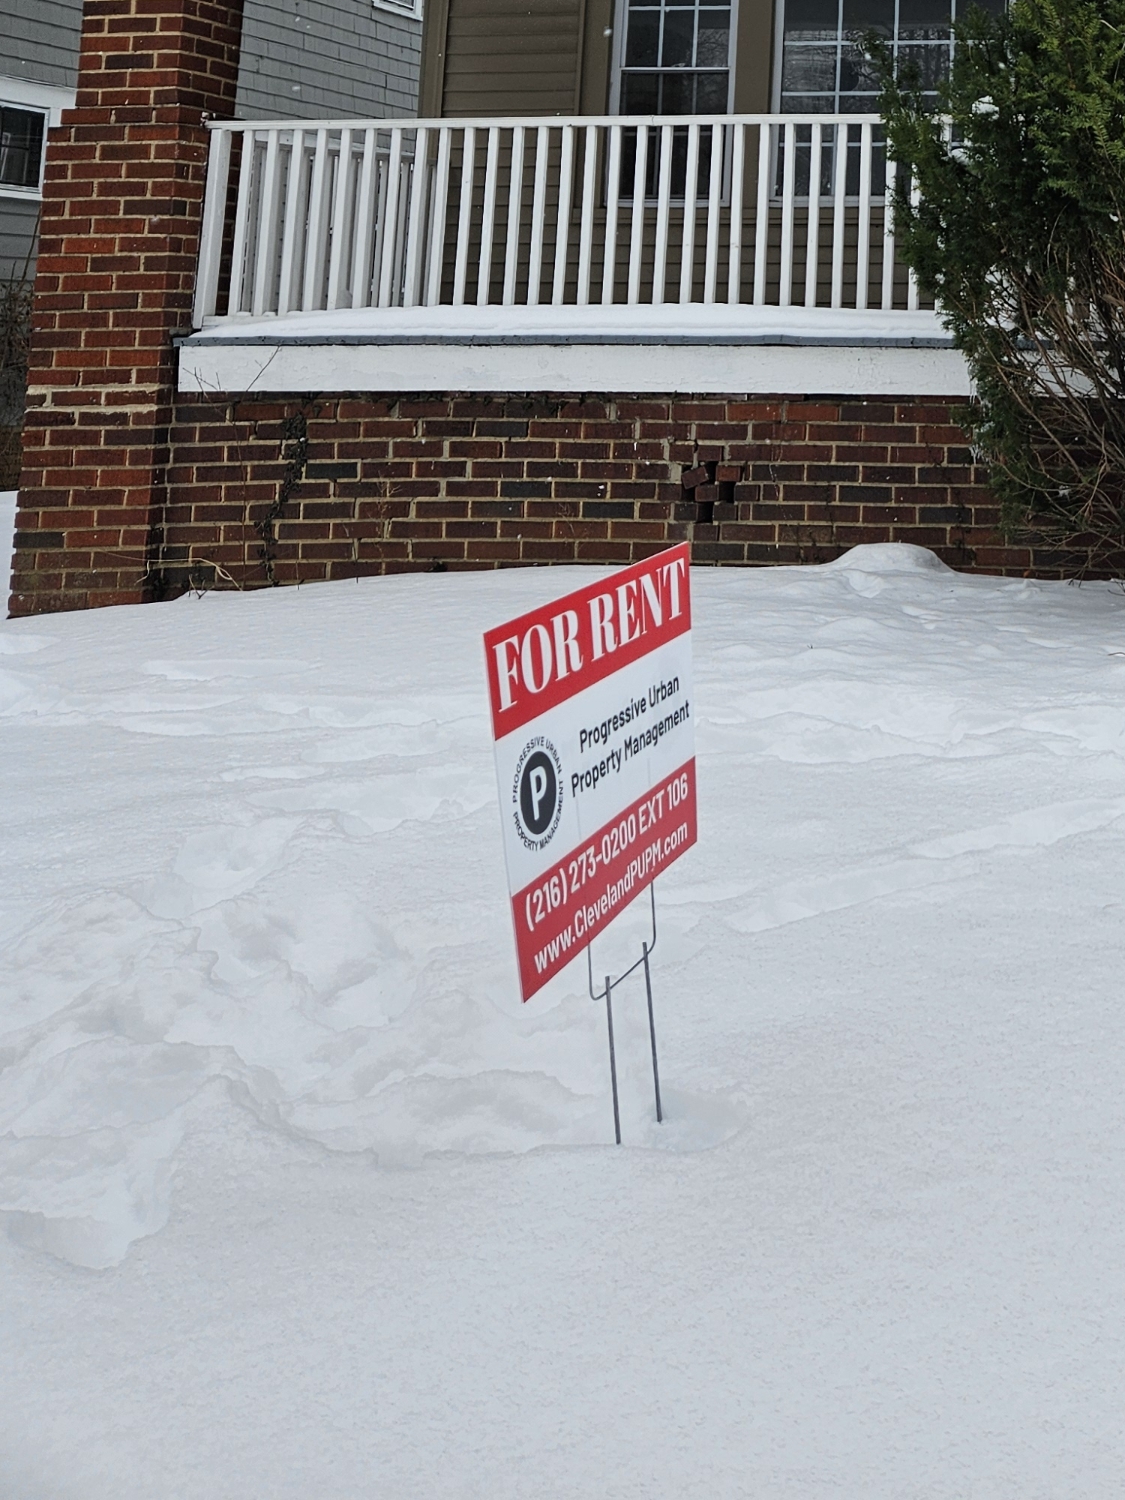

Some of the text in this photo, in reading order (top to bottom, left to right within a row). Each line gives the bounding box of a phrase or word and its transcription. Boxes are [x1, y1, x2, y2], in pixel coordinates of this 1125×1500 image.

[492, 557, 685, 713] FOR RENT
[571, 699, 690, 798] Property Management
[579, 676, 680, 754] Progressive Urban
[512, 736, 562, 804] PROGRESSIVE URBAN
[529, 765, 548, 821] P
[513, 780, 564, 852] PROPERTY MANAGEMENT
[525, 772, 689, 932] (216) 273-0200 EXT 106
[534, 821, 688, 974] www.ClevelandPUPM.com
